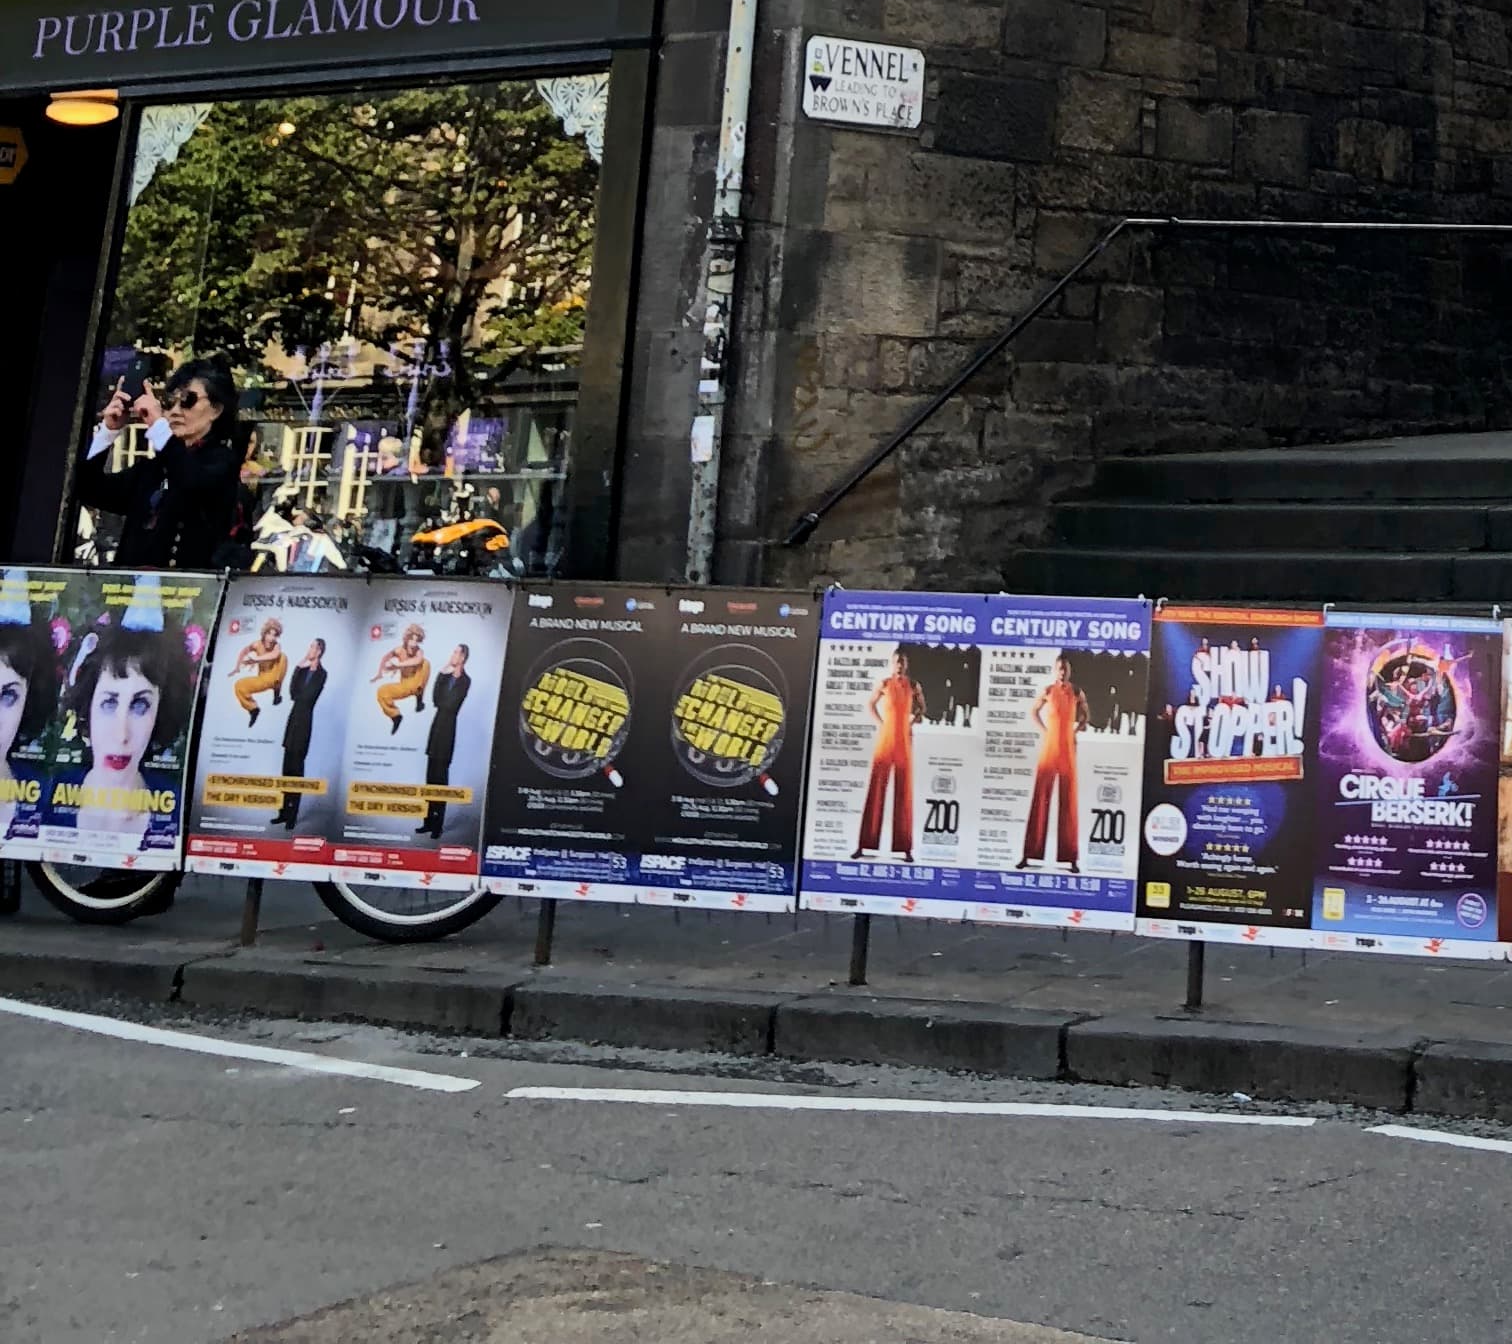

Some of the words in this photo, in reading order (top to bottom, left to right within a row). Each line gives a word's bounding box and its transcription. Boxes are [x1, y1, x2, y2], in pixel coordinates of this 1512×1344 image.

[32, 3, 214, 58] PURPLE
[826, 44, 908, 82] VENNEL
[835, 79, 877, 97] LEADING
[883, 85, 896, 97] TO
[813, 96, 871, 117] BROWN'S
[876, 103, 913, 121] PLACE
[243, 594, 275, 610] URSUS
[384, 599, 416, 613] URSUS
[529, 617, 540, 628] A
[540, 618, 573, 629] BRAND
[575, 619, 599, 630] NEW
[600, 620, 643, 632] MUSICAL
[680, 622, 690, 634] A
[690, 623, 726, 636] BRAND
[728, 624, 751, 637] NEW
[753, 626, 797, 639] MUSICAL
[830, 611, 919, 632] CENTURY
[924, 614, 976, 634] SONG
[991, 616, 1083, 638] CENTURY
[1088, 620, 1142, 640] SONG
[1192, 646, 1271, 705] SHOW
[1170, 677, 1308, 759] STOPPER!
[52, 783, 176, 813] AWAKENING
[206, 792, 220, 801] THE
[243, 793, 277, 804] VERSION
[1339, 774, 1425, 799] CIRQUE
[350, 801, 363, 810] THE
[387, 802, 422, 813] VERSION
[924, 799, 960, 834] ZOO
[1371, 800, 1475, 827] BERSERK!
[1089, 809, 1126, 844] ZOO
